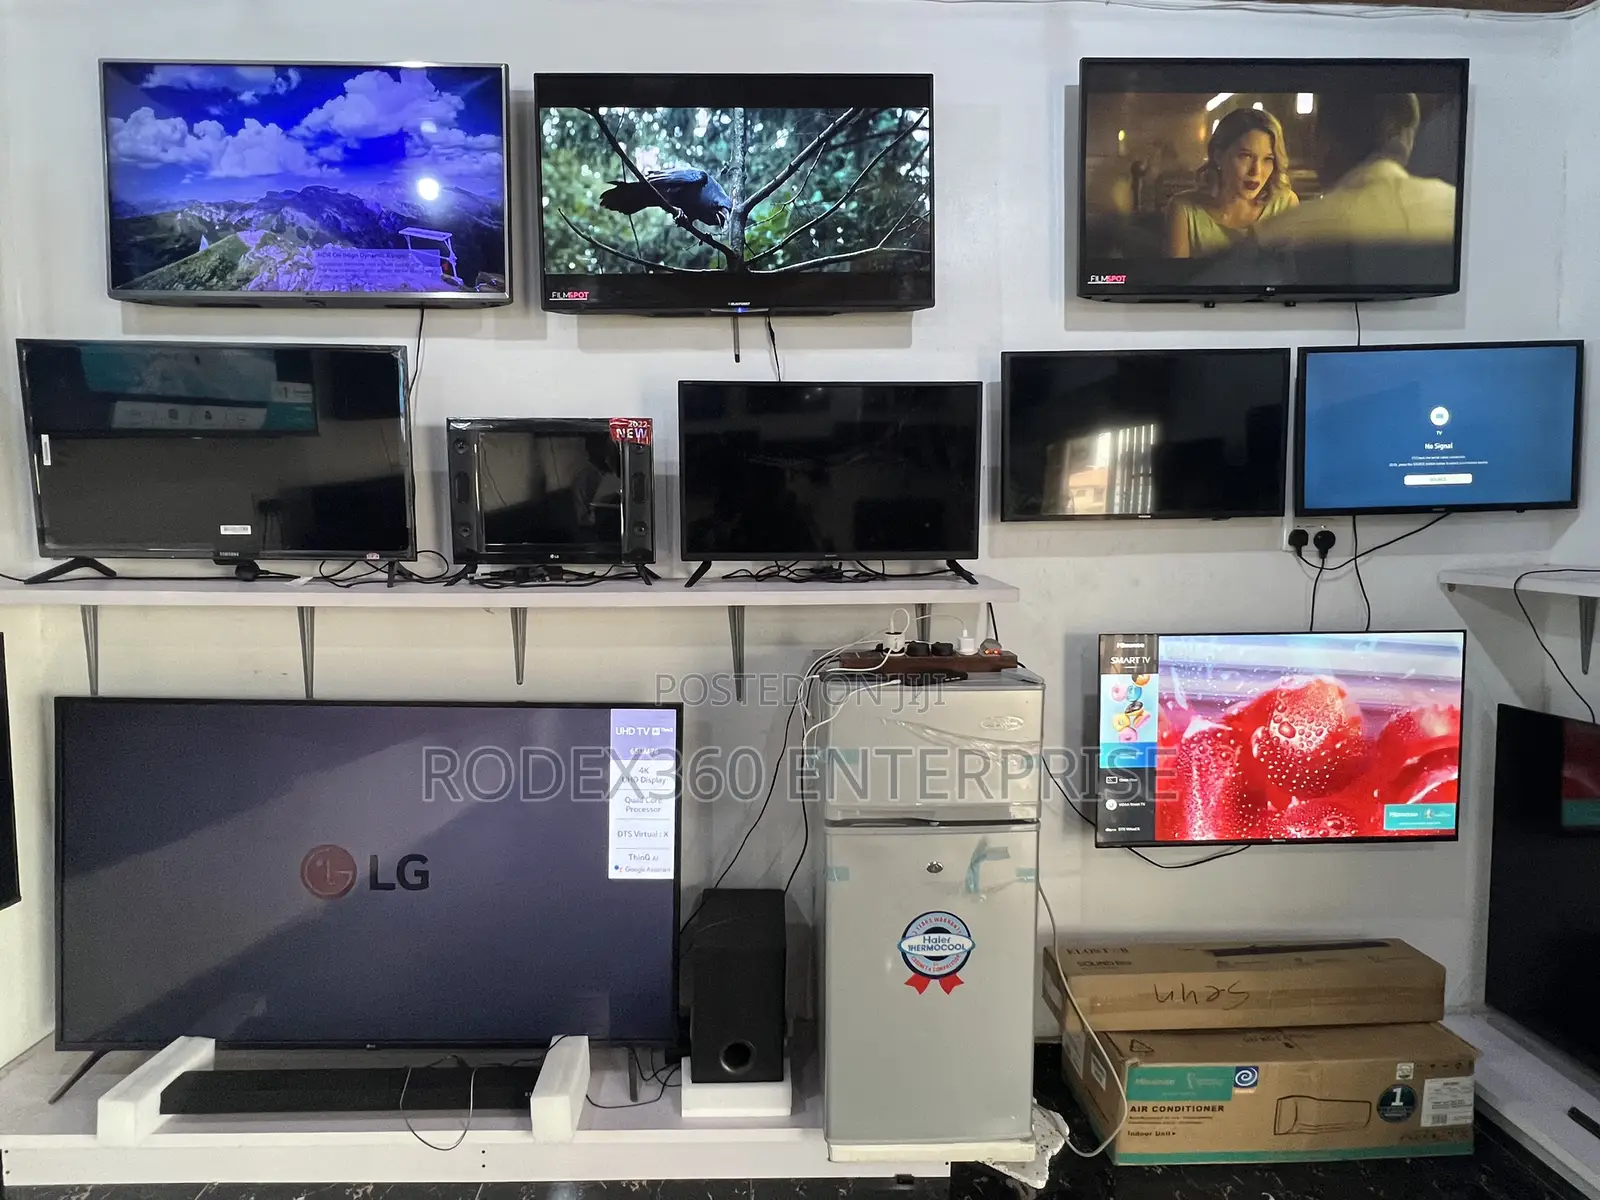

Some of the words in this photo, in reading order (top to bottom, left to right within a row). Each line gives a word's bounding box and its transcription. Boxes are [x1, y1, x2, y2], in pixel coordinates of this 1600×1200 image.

[616, 428, 647, 439] NEW
[1434, 442, 1453, 451] Signal
[1110, 656, 1140, 664] SMART
[1141, 656, 1151, 664] TV
[615, 726, 636, 736] UHD
[636, 726, 651, 736] TV
[640, 775, 667, 785] Display
[625, 805, 661, 813] Processor
[617, 830, 633, 838] DTS
[633, 830, 658, 838] Virtual
[369, 853, 430, 891] LG
[923, 935, 952, 944] Haier
[1390, 1087, 1404, 1106] 1
[1129, 1105, 1148, 1113] AIR
[1151, 1105, 1225, 1113] CONDITIONER
